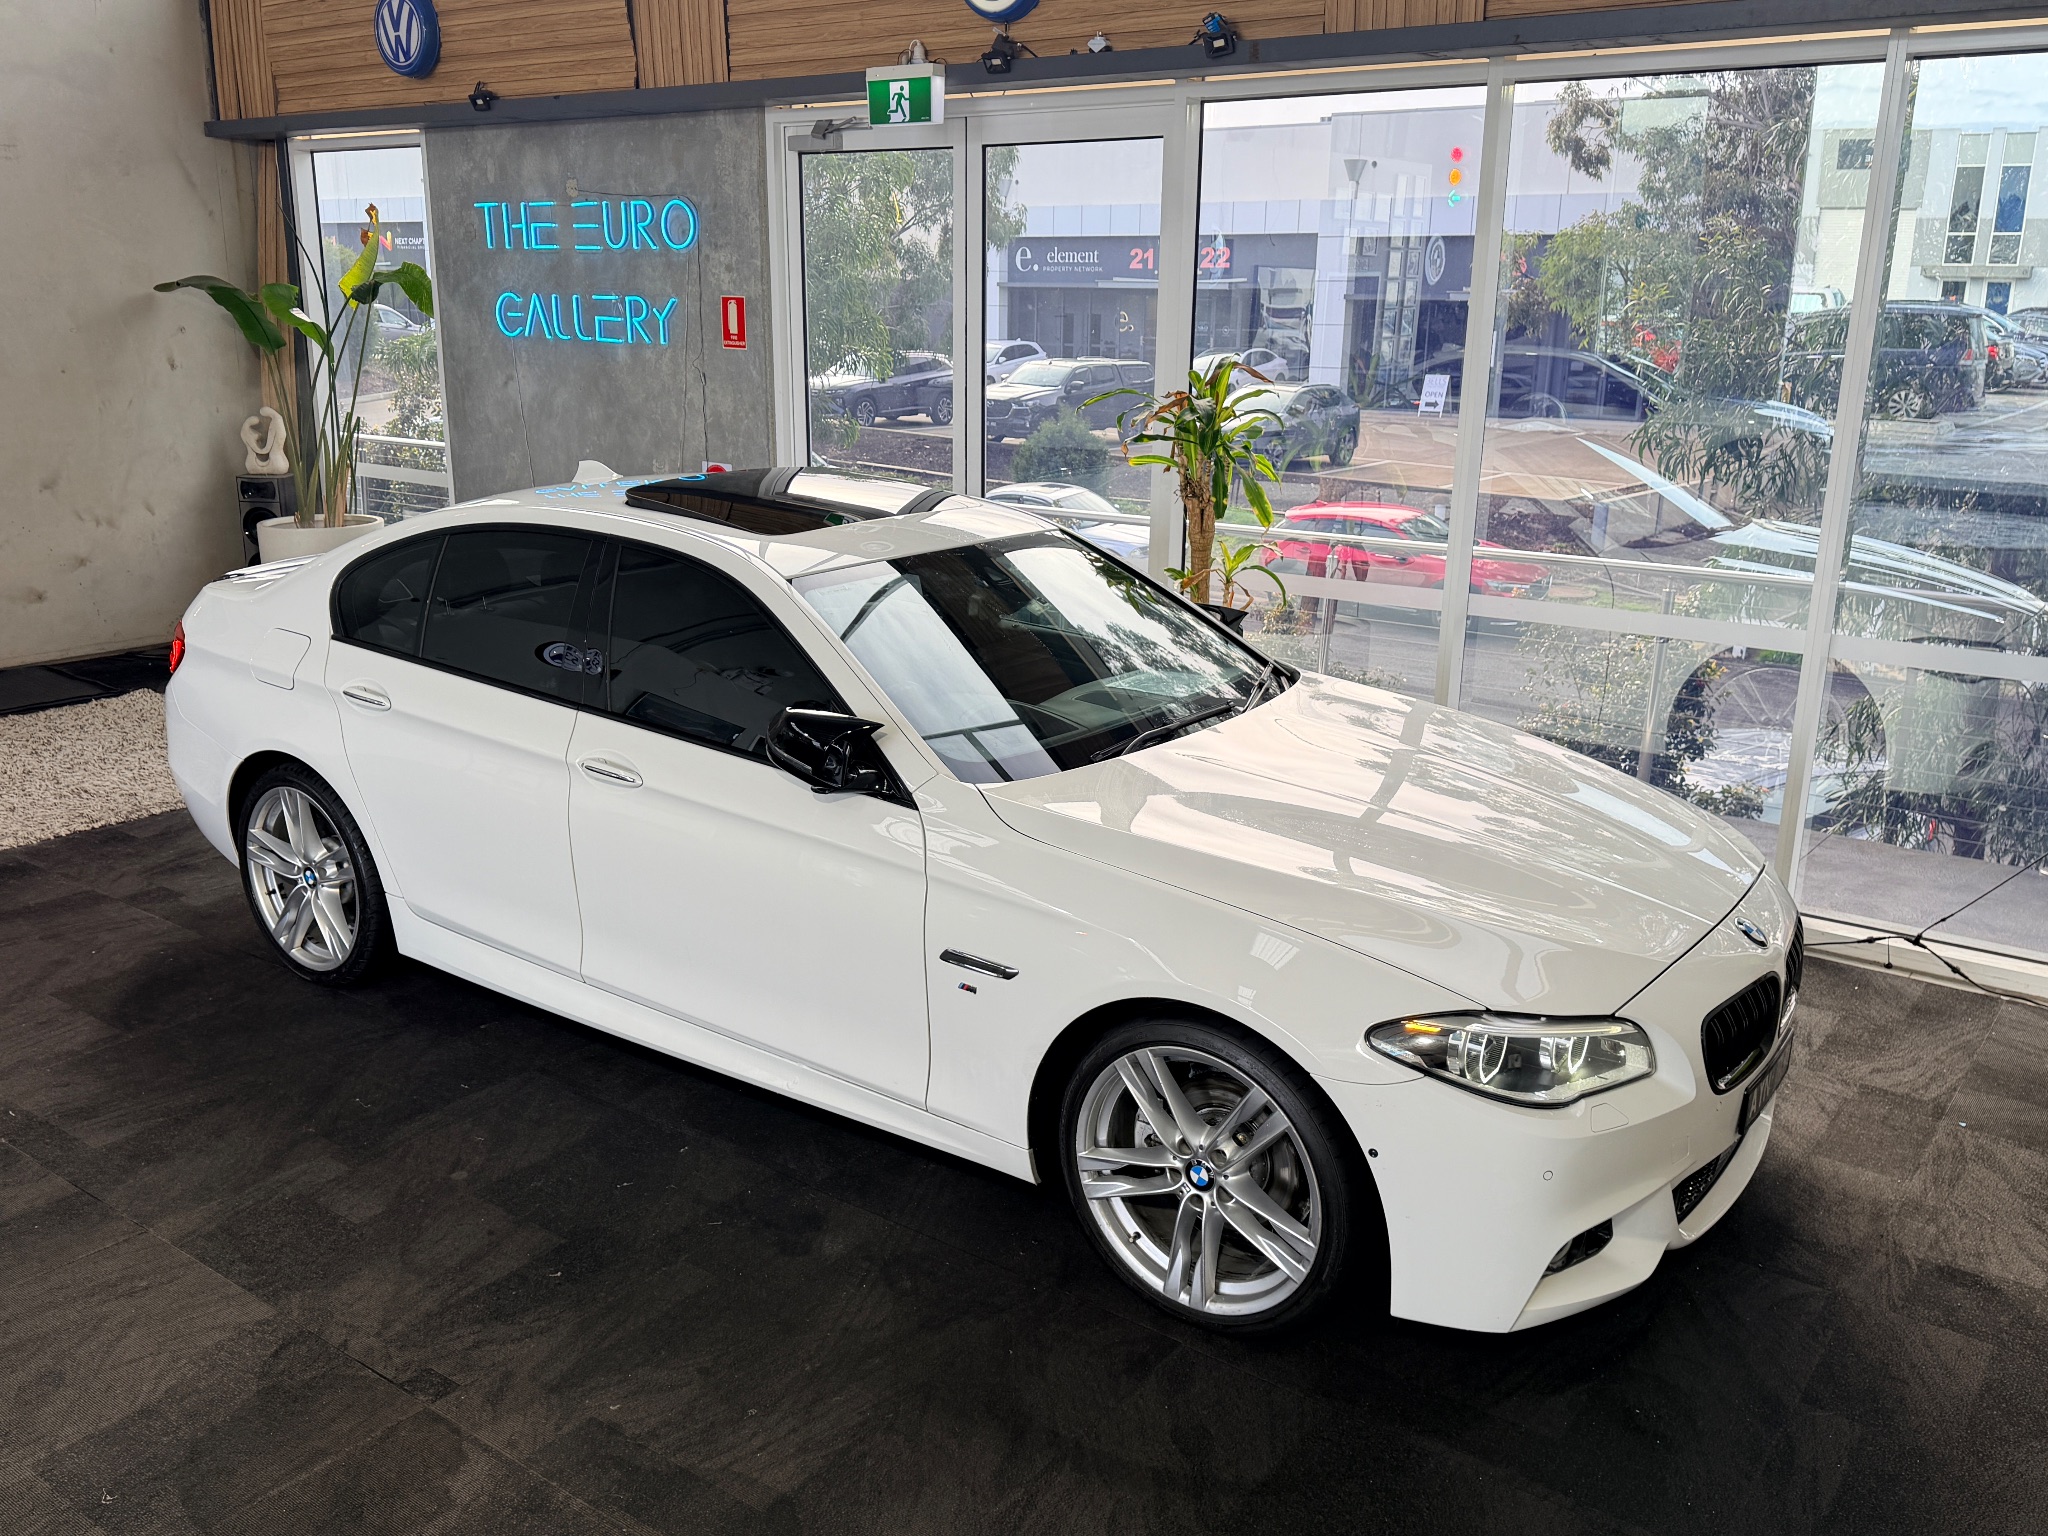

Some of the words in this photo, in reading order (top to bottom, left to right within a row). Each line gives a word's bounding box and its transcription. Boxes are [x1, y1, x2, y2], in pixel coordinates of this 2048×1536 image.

[474, 201, 559, 250] THE
[571, 198, 698, 251] EURO
[394, 237, 408, 245] NEXT
[1046, 246, 1099, 264] element
[1129, 248, 1154, 270] 21
[1200, 247, 1231, 269] 22
[1042, 265, 1073, 273] PROPERTY
[495, 291, 678, 345] GALLERY
